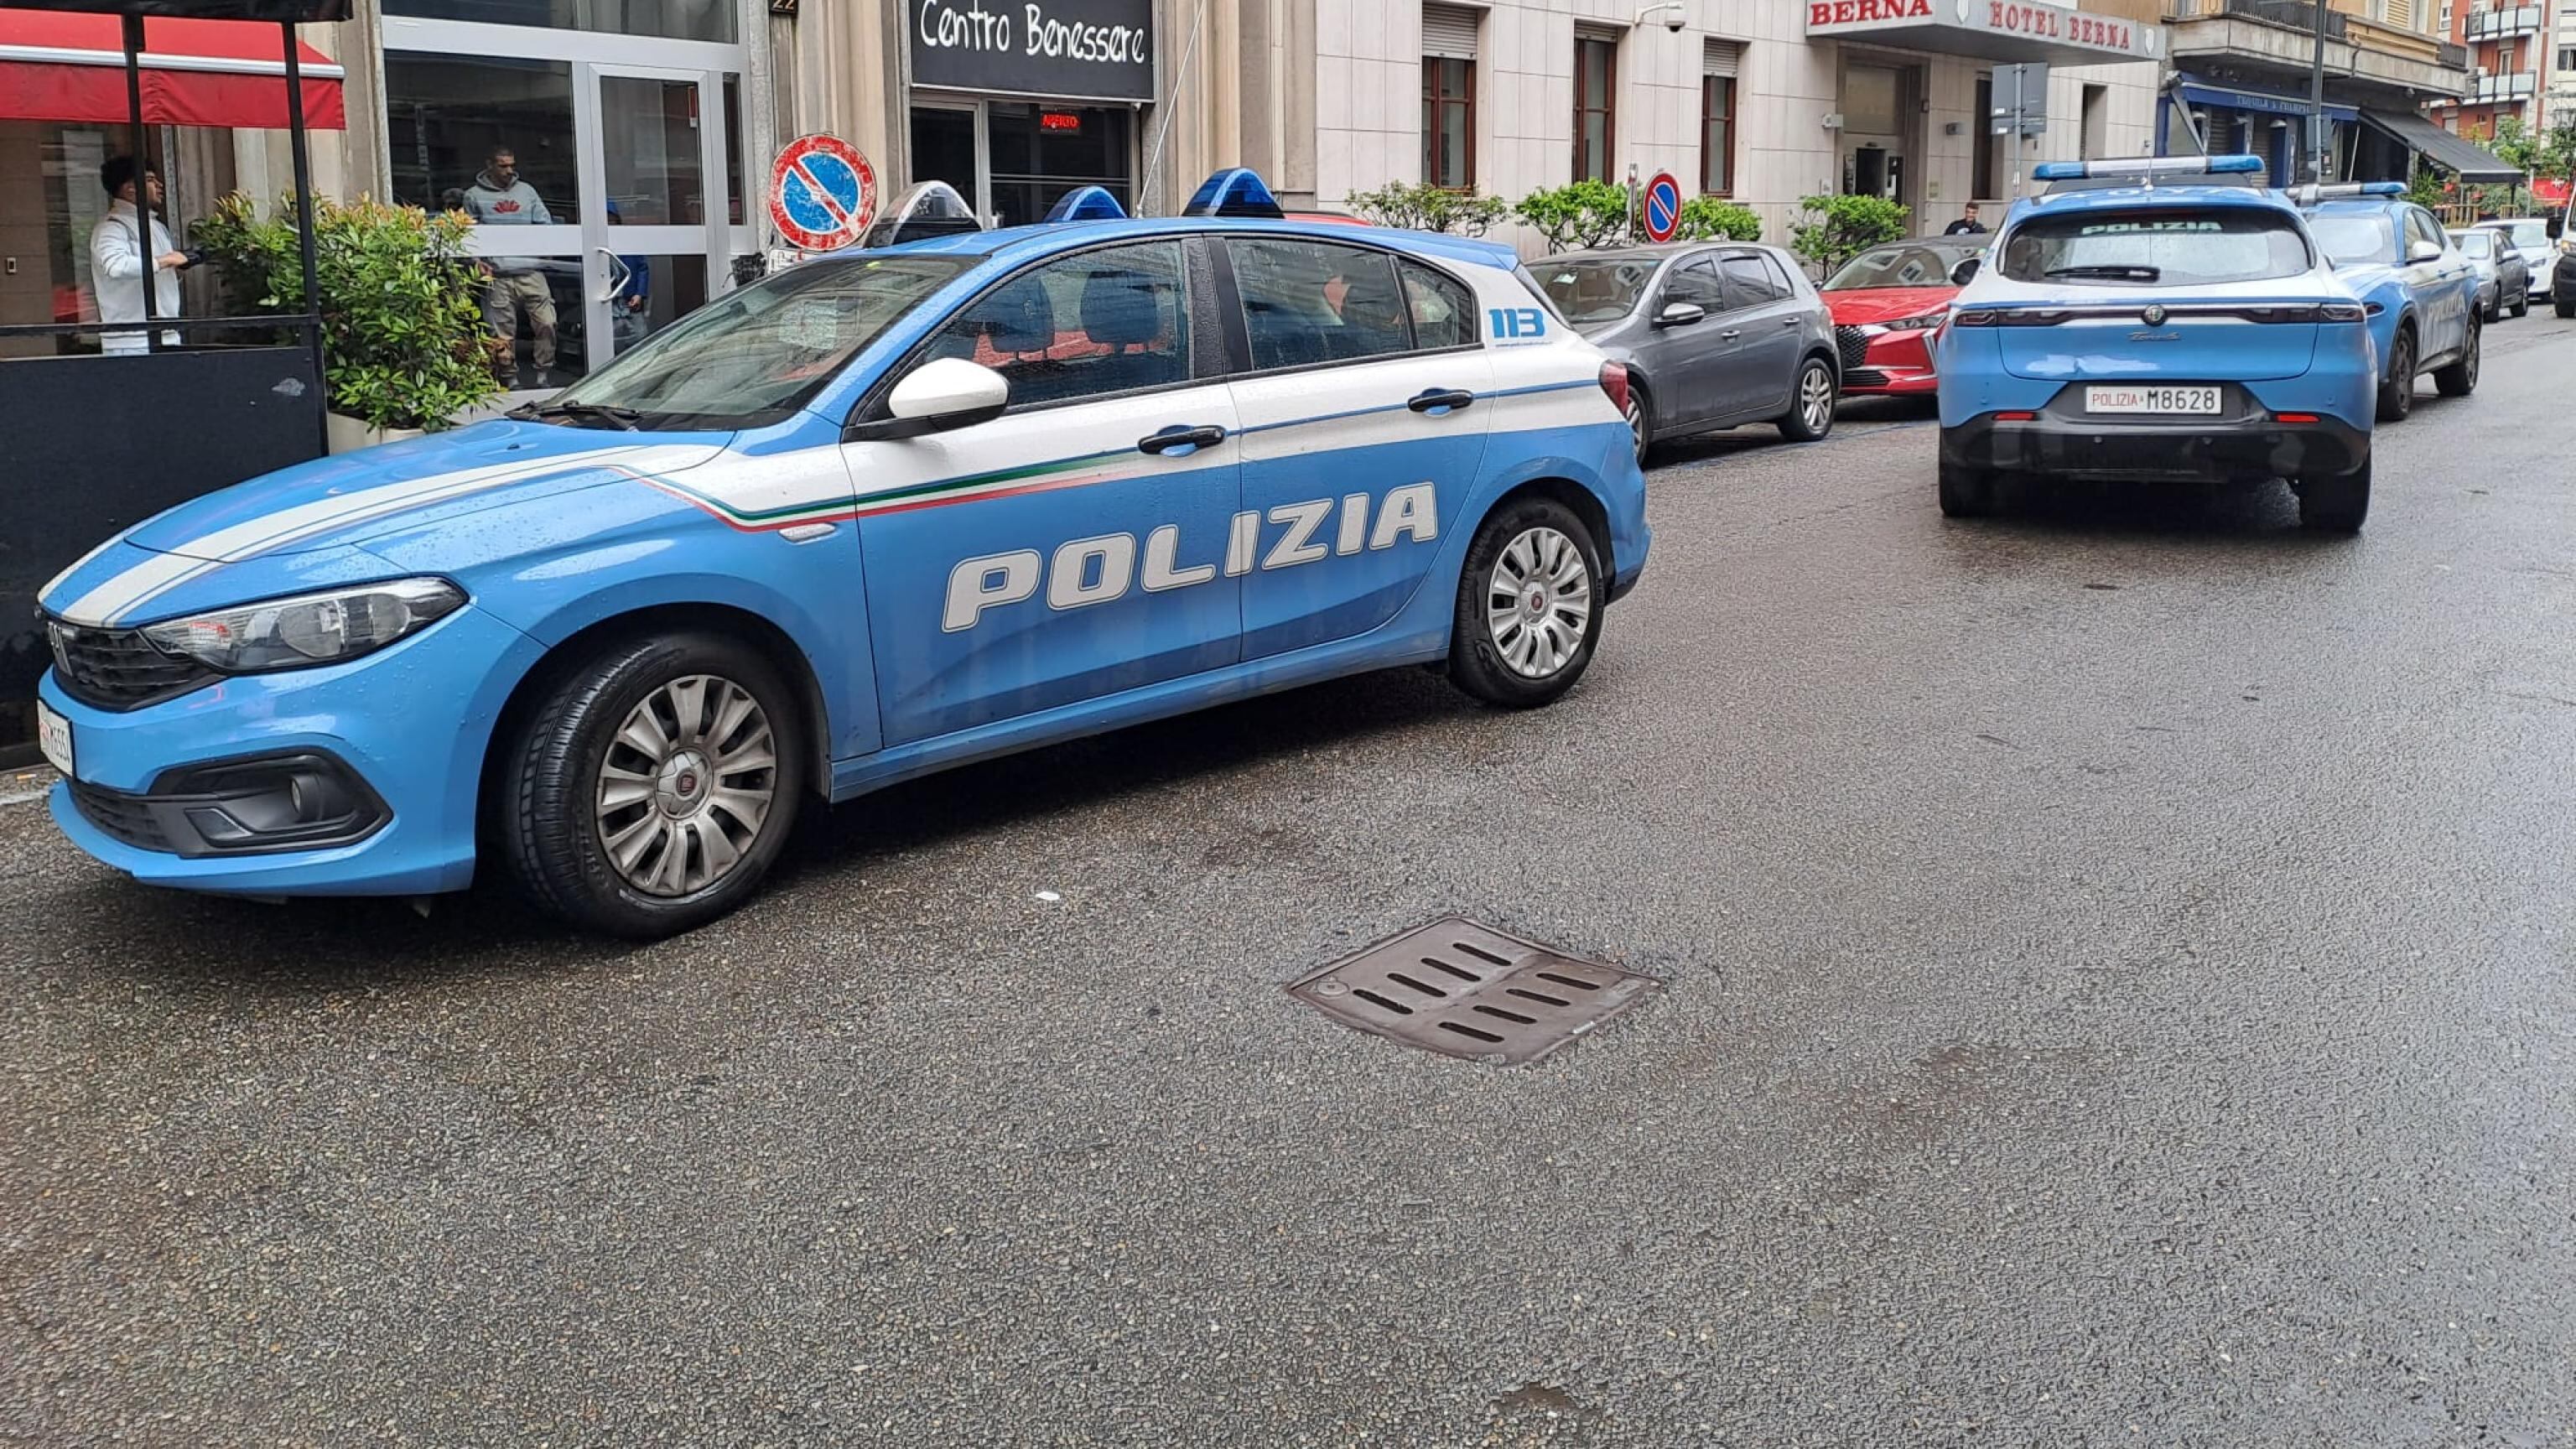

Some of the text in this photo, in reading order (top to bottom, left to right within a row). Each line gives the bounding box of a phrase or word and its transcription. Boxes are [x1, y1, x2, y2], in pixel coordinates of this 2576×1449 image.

[1810, 0, 1932, 26] BERNA
[1989, 2, 2130, 49] HOTEL BERNA
[920, 0, 1145, 64] Centro Benessere
[2082, 221, 2222, 235] POLIZIA
[1488, 308, 1545, 339] 113
[2092, 389, 2215, 410] POLIZIA M8628
[942, 480, 1439, 633] POLIZIA
